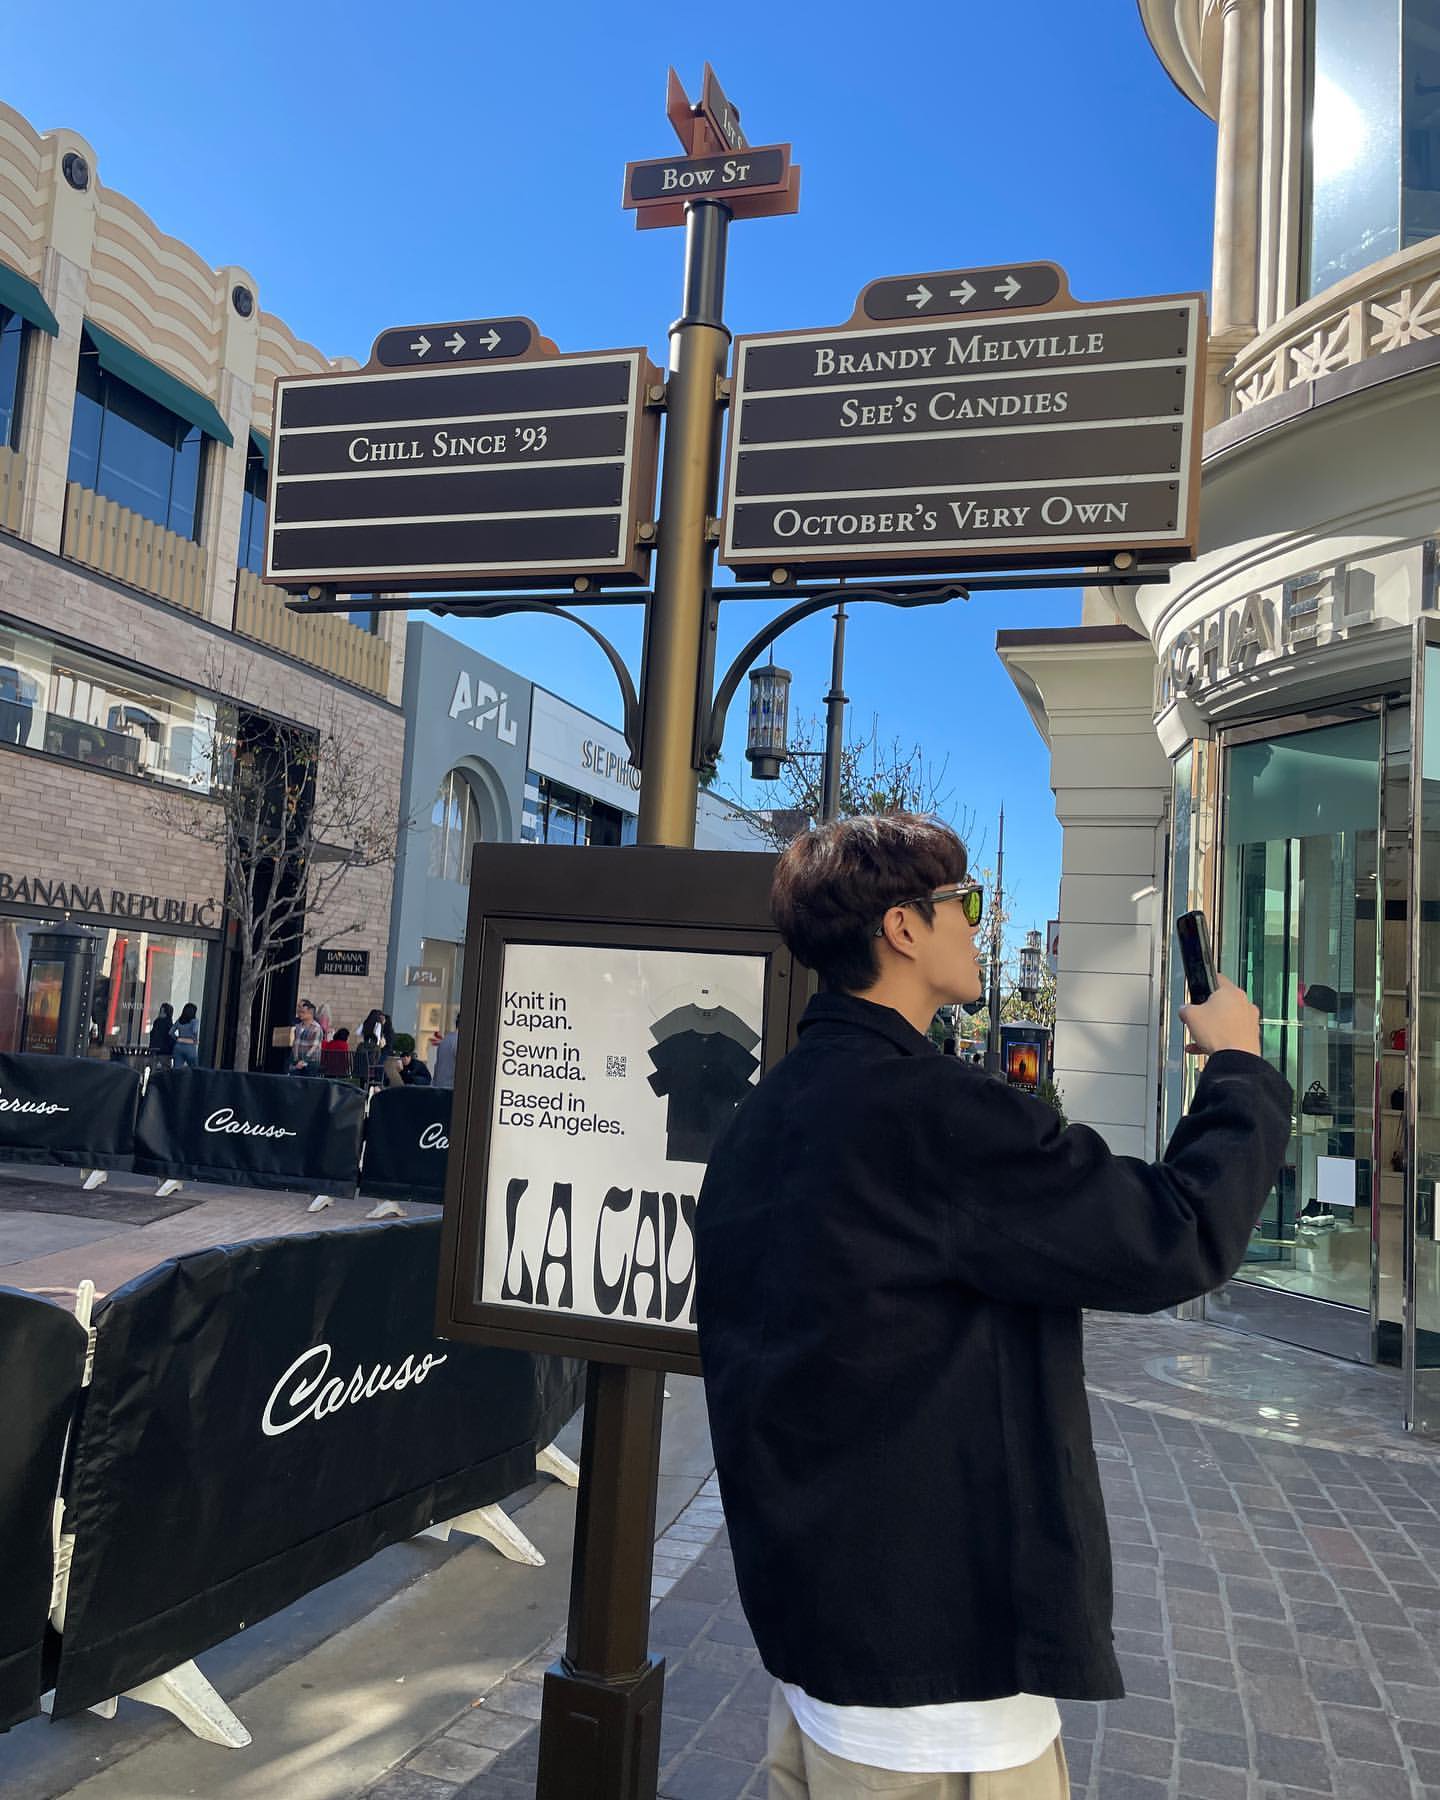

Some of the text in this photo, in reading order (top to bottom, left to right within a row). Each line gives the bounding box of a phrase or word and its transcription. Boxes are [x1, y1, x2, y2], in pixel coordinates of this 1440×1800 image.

[661, 161, 751, 191] BOW ST
[813, 333, 1105, 377] BRANDY MELVILLE
[839, 391, 1069, 427] SEE'S CANDIES
[349, 426, 549, 463] CHILL SINCE '93
[772, 496, 1129, 537] OCTOBER'S VERY OWN
[448, 670, 518, 746] APL
[582, 739, 641, 791] SEPHO
[0, 872, 215, 929] BANANA REPUBLIC
[324, 962, 365, 974] REPUBLIC
[327, 951, 363, 962] BANANA
[503, 991, 567, 1012] Knit in
[503, 1010, 573, 1032] Japan.
[502, 1040, 580, 1062] Sewn in
[501, 1058, 586, 1081] Canada.
[0, 1088, 70, 1115] aruso
[500, 1089, 585, 1112] Based in
[204, 1108, 297, 1138] Caruso
[498, 1108, 625, 1136] Los Angeles.
[501, 1178, 573, 1309] LA
[261, 1343, 448, 1436] Caruso
